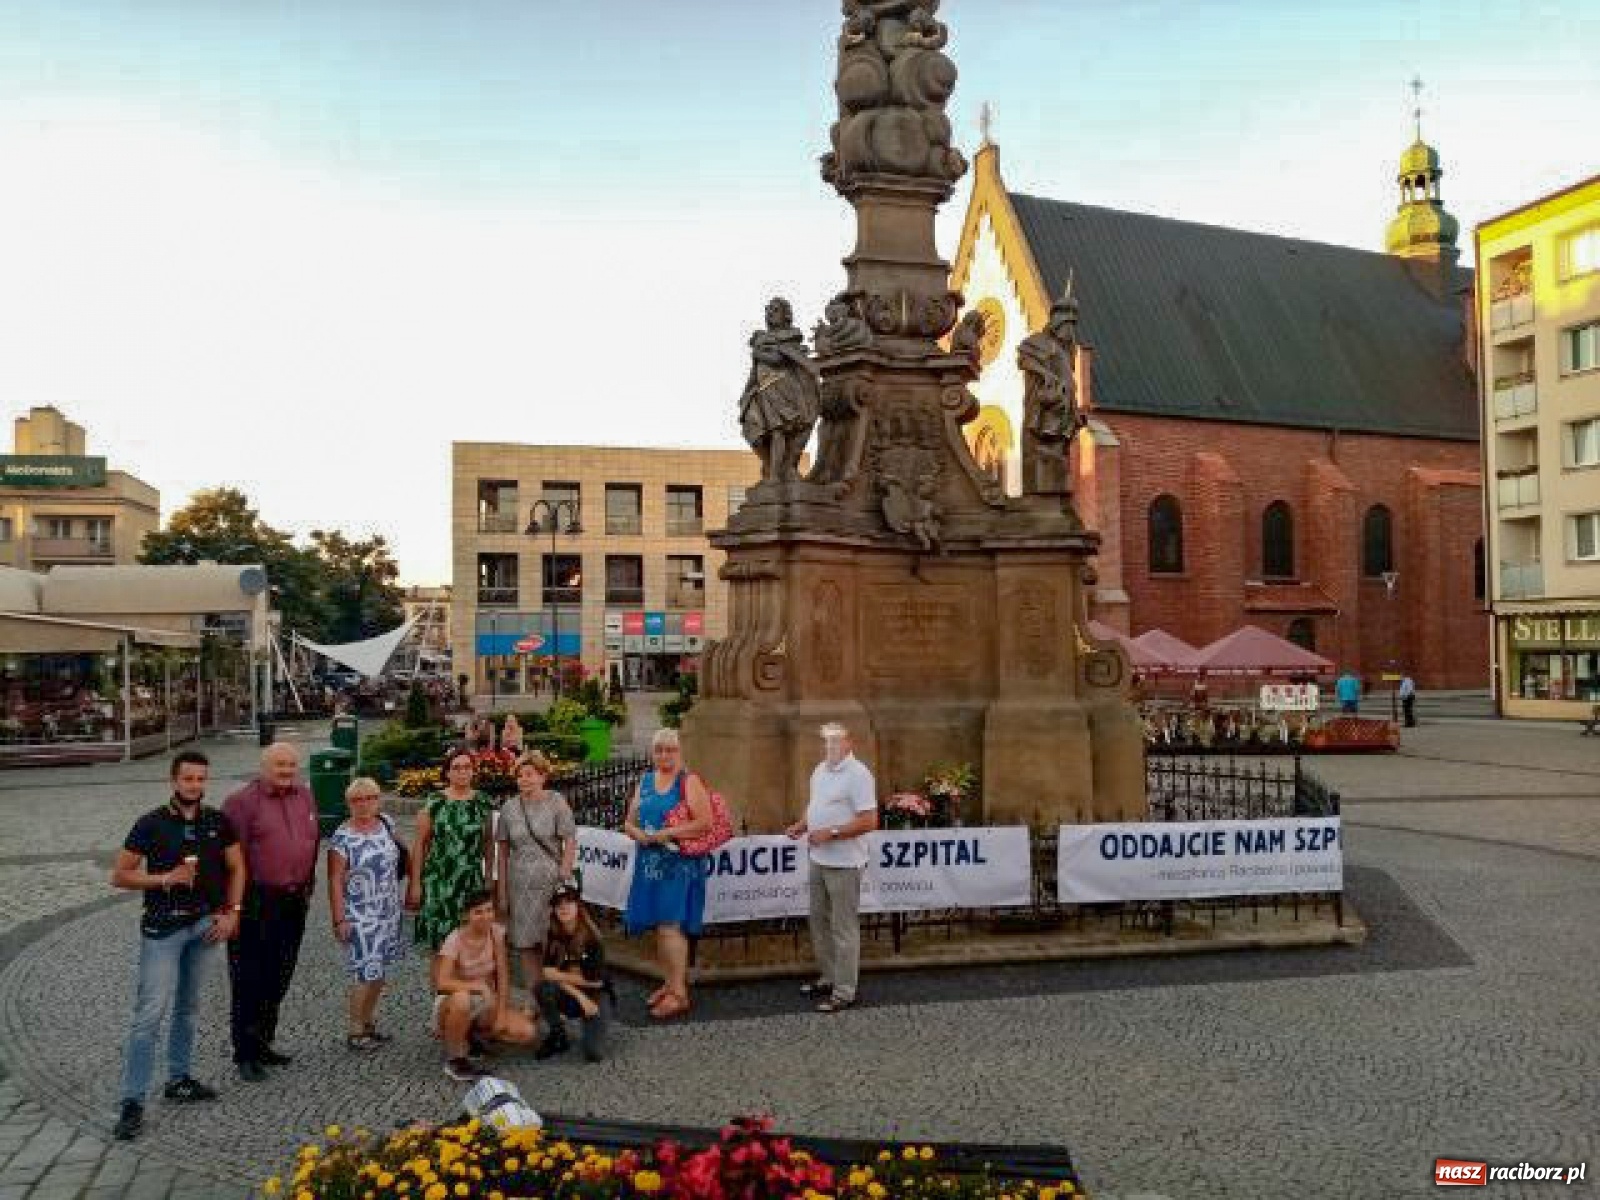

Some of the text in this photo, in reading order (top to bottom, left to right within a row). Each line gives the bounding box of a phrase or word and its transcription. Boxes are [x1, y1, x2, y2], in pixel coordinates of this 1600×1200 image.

[1514, 617, 1600, 641] STELL
[705, 839, 987, 876] DAJCIE SZPITAL
[1100, 832, 1226, 860] ODDAJCIE
[1234, 829, 1286, 854] NAM
